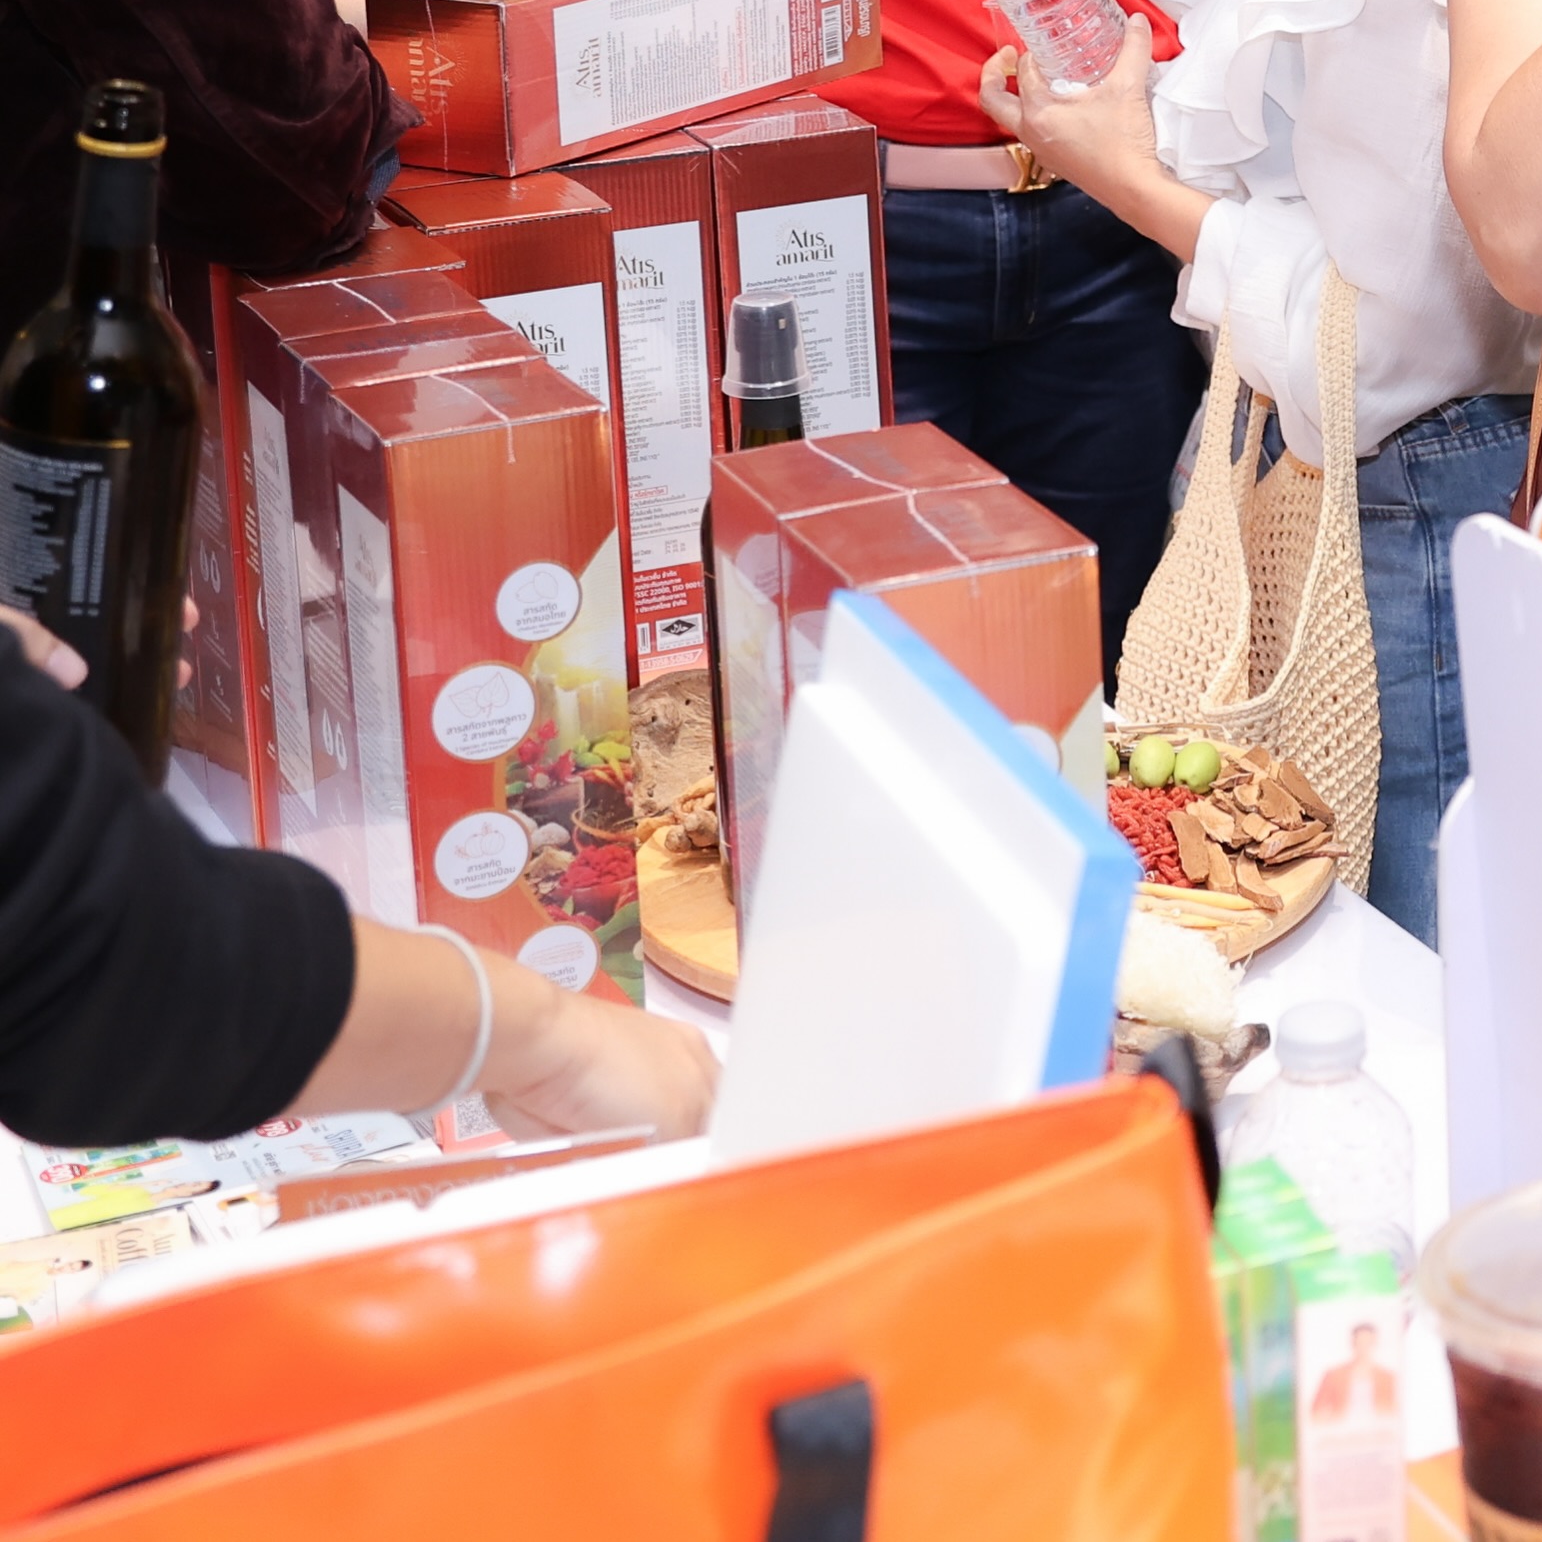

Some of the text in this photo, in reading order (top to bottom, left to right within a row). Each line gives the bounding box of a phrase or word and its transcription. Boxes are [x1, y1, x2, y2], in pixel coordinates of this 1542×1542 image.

[576, 47, 591, 89] Atis
[590, 35, 602, 99] amarit
[786, 229, 826, 251] Atis
[776, 244, 838, 267] amarit
[462, 733, 469, 742] 2
[466, 858, 502, 873] สารสกัด
